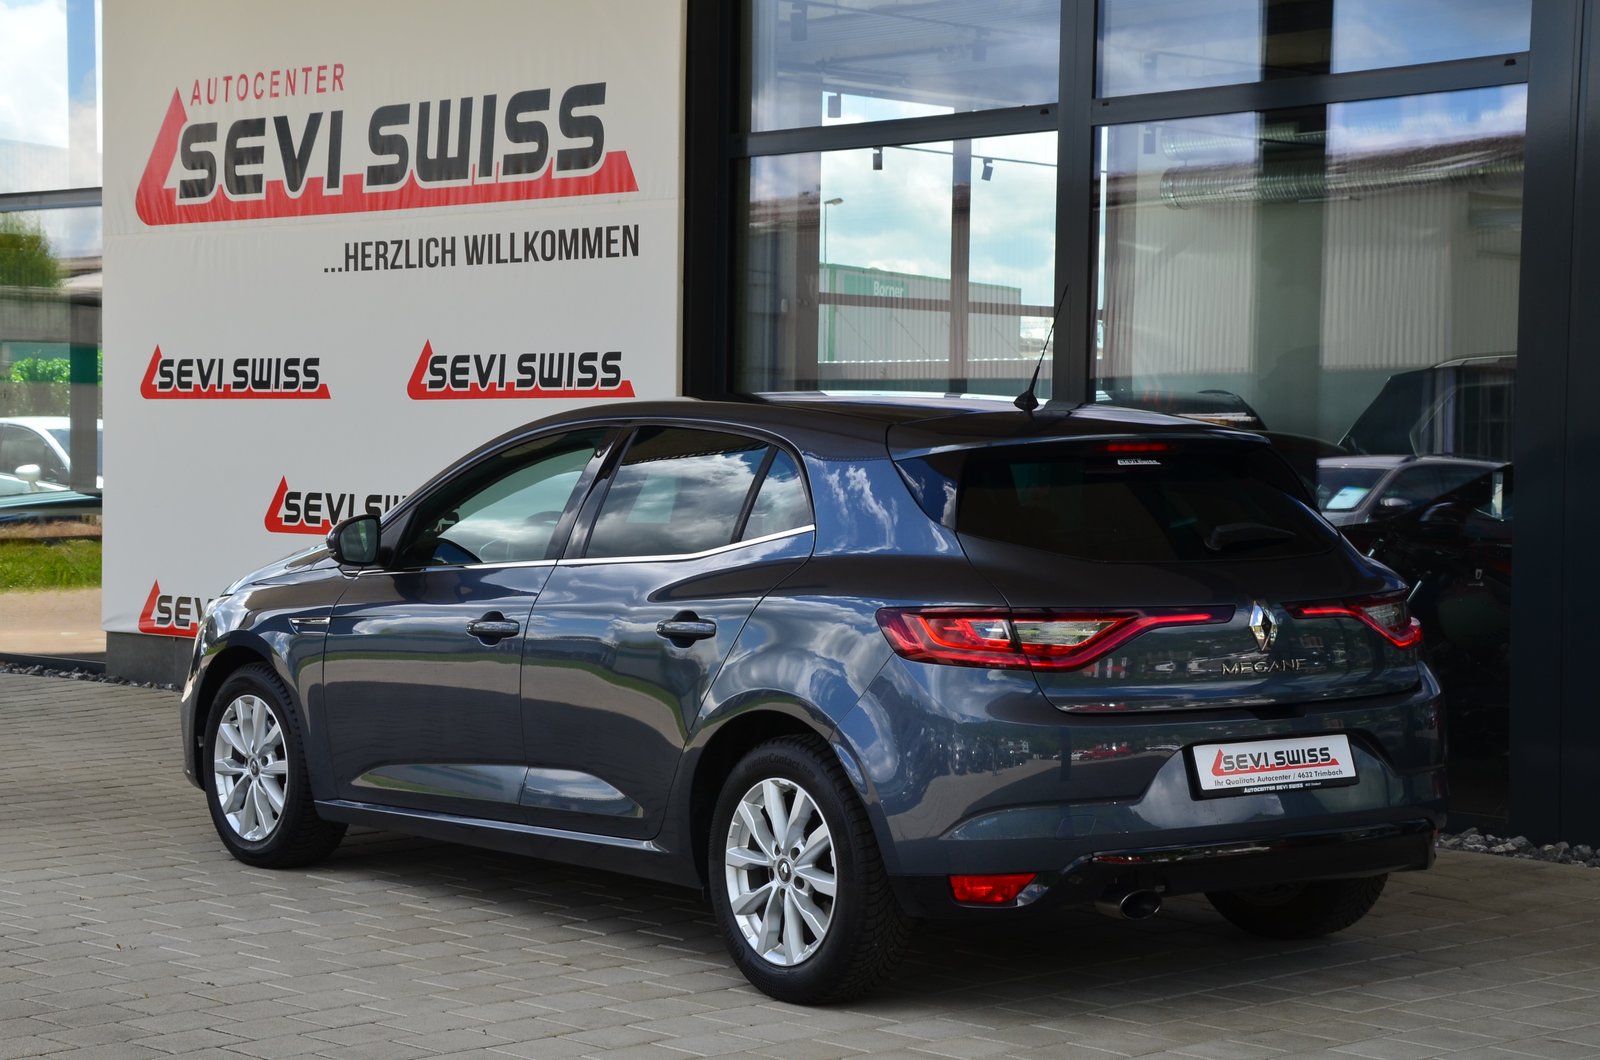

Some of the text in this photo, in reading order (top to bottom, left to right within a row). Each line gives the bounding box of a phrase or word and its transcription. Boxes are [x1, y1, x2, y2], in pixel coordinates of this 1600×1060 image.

[191, 63, 345, 106] AUTOCENTER
[179, 82, 606, 199] SEVI SWISS
[324, 224, 639, 273] ...HERZLICH WILLKOMMEN
[158, 358, 320, 390] SEVI SWISS
[428, 351, 622, 389] SEVI SWISS
[284, 491, 355, 525] SEVI
[1222, 747, 1331, 771] SEVI SWISS
[1214, 779, 1224, 787] Ihr
[1257, 774, 1291, 783] Autocenter
[1297, 771, 1313, 779] 4632
[1315, 769, 1343, 777] Trimbach
